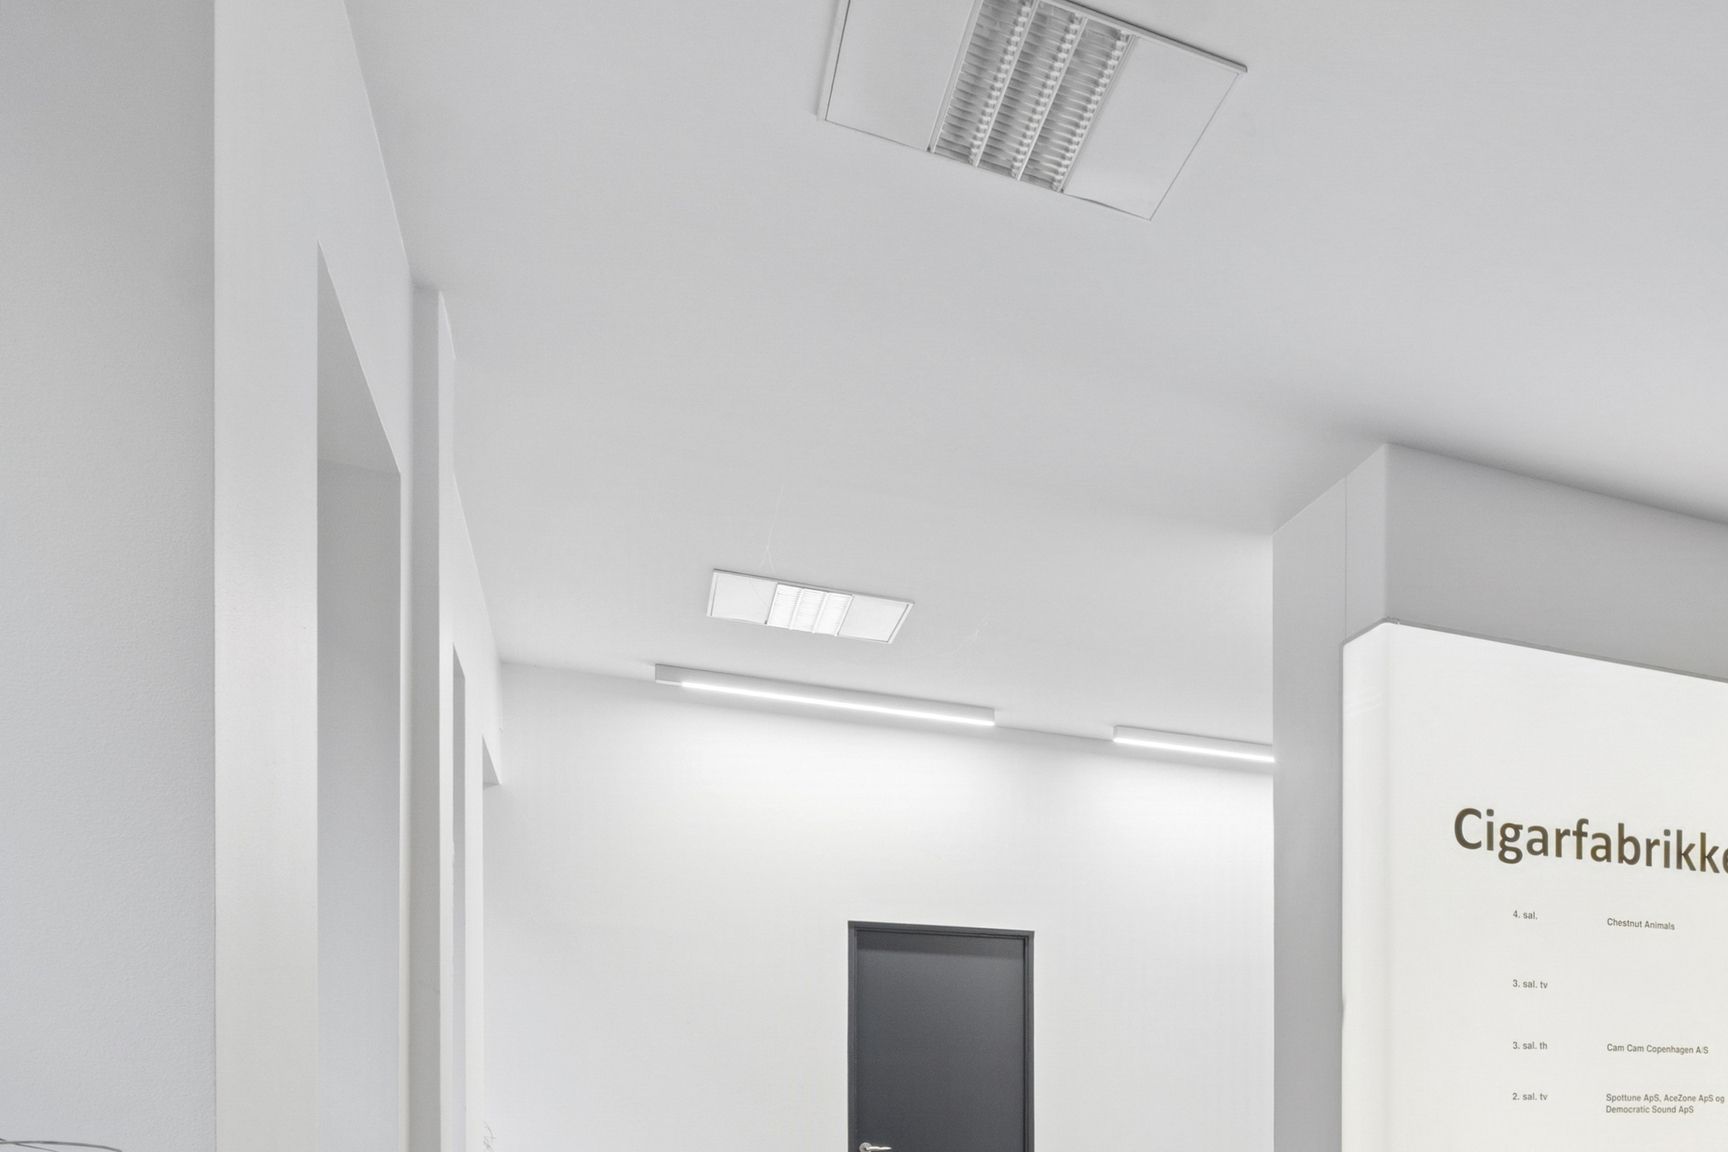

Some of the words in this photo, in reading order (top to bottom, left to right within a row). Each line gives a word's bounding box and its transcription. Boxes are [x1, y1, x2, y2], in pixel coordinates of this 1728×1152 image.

[1513, 910, 1520, 918] 4.
[1523, 912, 1538, 920] sal.
[1607, 918, 1642, 928] Chestnut
[1644, 920, 1675, 931] Animals
[1512, 979, 1520, 988] 3.
[1523, 980, 1538, 988] sal.
[1540, 981, 1548, 989] tv
[1512, 1042, 1520, 1050] 3.
[1523, 1042, 1537, 1050] sal.
[1540, 1042, 1548, 1050] th
[1607, 1044, 1624, 1052] Cam
[1627, 1044, 1644, 1052] Cam
[1646, 1045, 1694, 1055] Copenhagen
[1512, 1092, 1520, 1100] 2.
[1522, 1092, 1537, 1101] sal.
[1540, 1093, 1548, 1101] tv
[1606, 1094, 1641, 1103] Spottune
[1664, 1094, 1696, 1102] AceZone
[1698, 1094, 1713, 1103] ApS
[1716, 1096, 1725, 1104] og
[1606, 1105, 1650, 1113] Democratic
[1679, 1106, 1694, 1114] ApS
